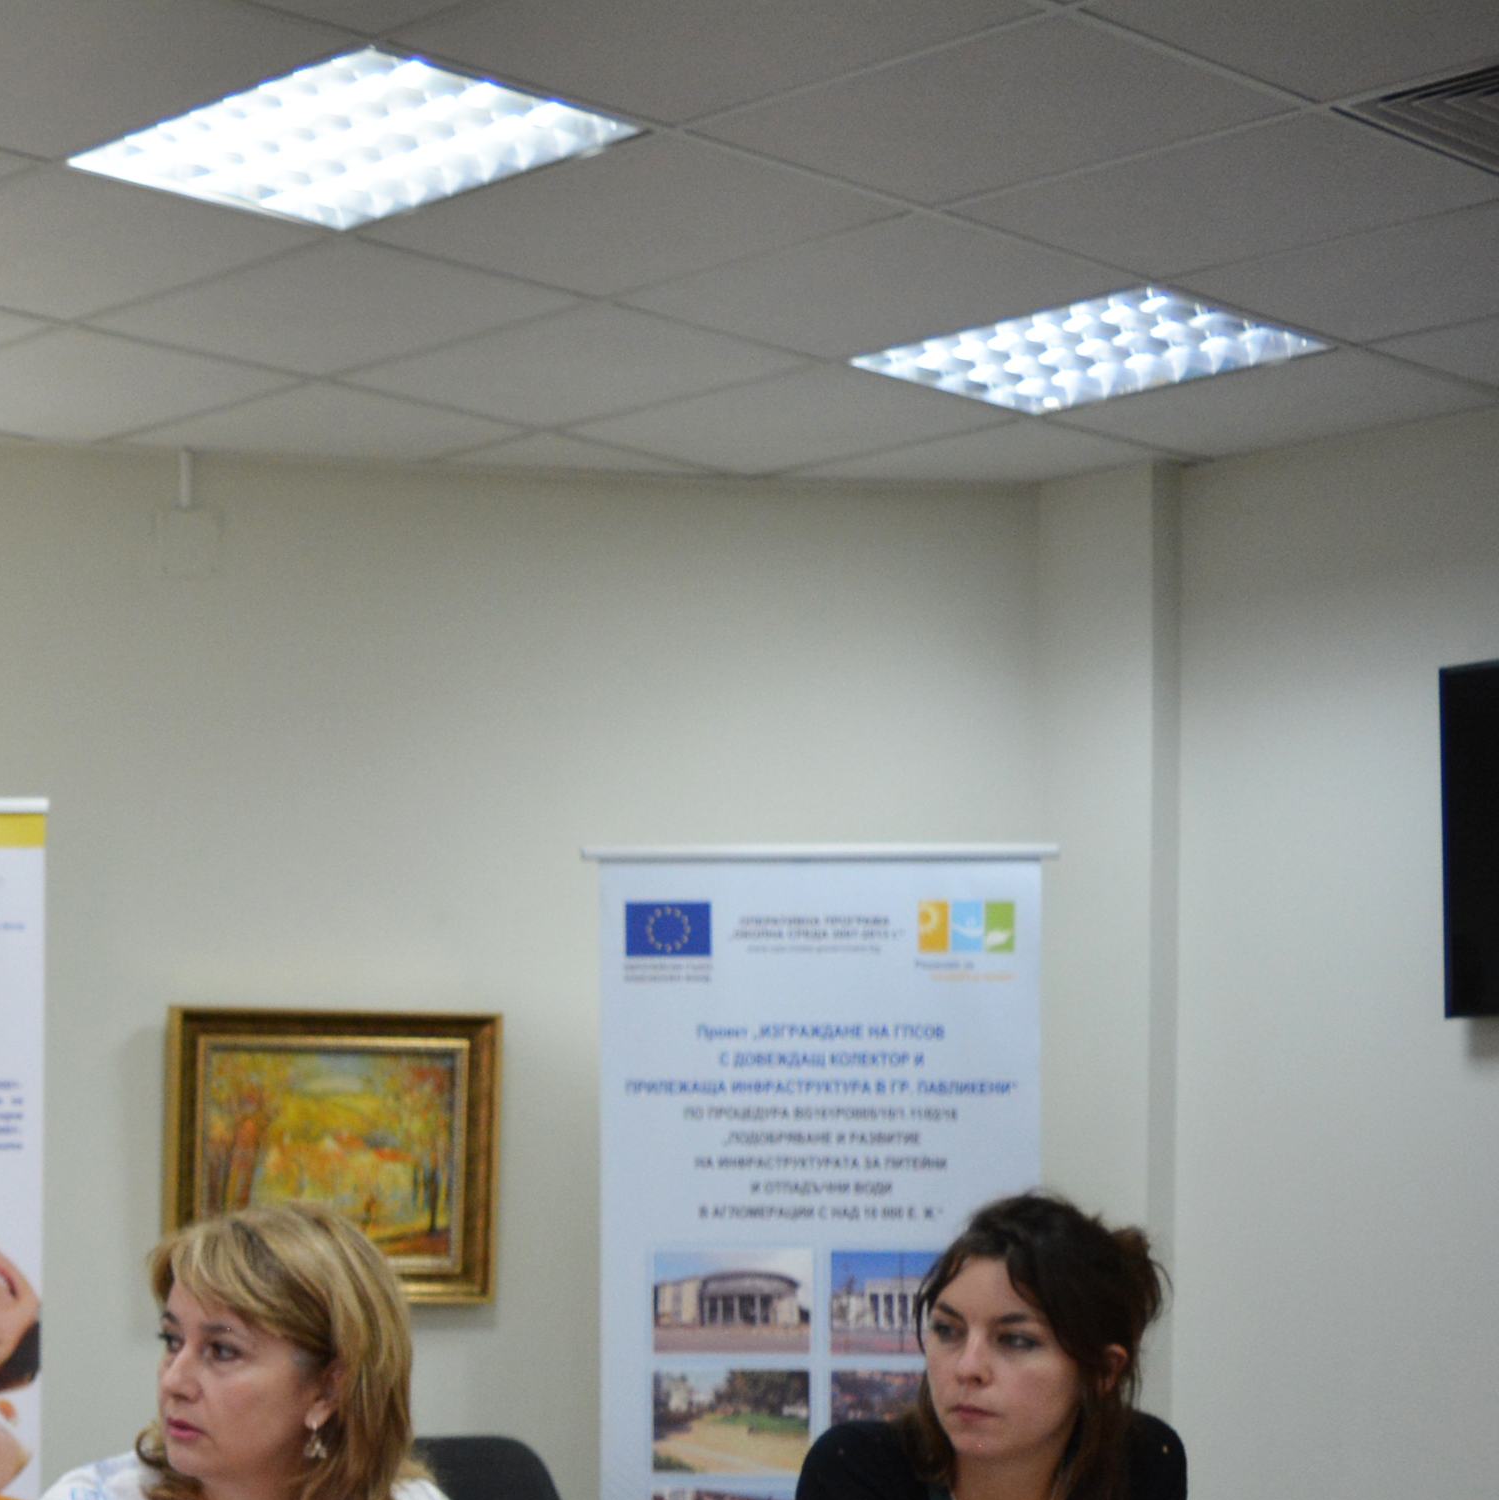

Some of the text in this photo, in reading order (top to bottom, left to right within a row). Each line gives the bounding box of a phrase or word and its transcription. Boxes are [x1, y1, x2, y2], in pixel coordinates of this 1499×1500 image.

[868, 1024, 890, 1039] НА
[894, 1024, 946, 1039] ГПСОВ
[719, 1051, 925, 1068] С ДОВЕЖДАЩ КОЛЕКТОР И
[625, 1078, 727, 1096] ПРИЛЕЖАЩА
[731, 1079, 872, 1095] ИНФРАСТРУКТУРА
[875, 1080, 887, 1094] В
